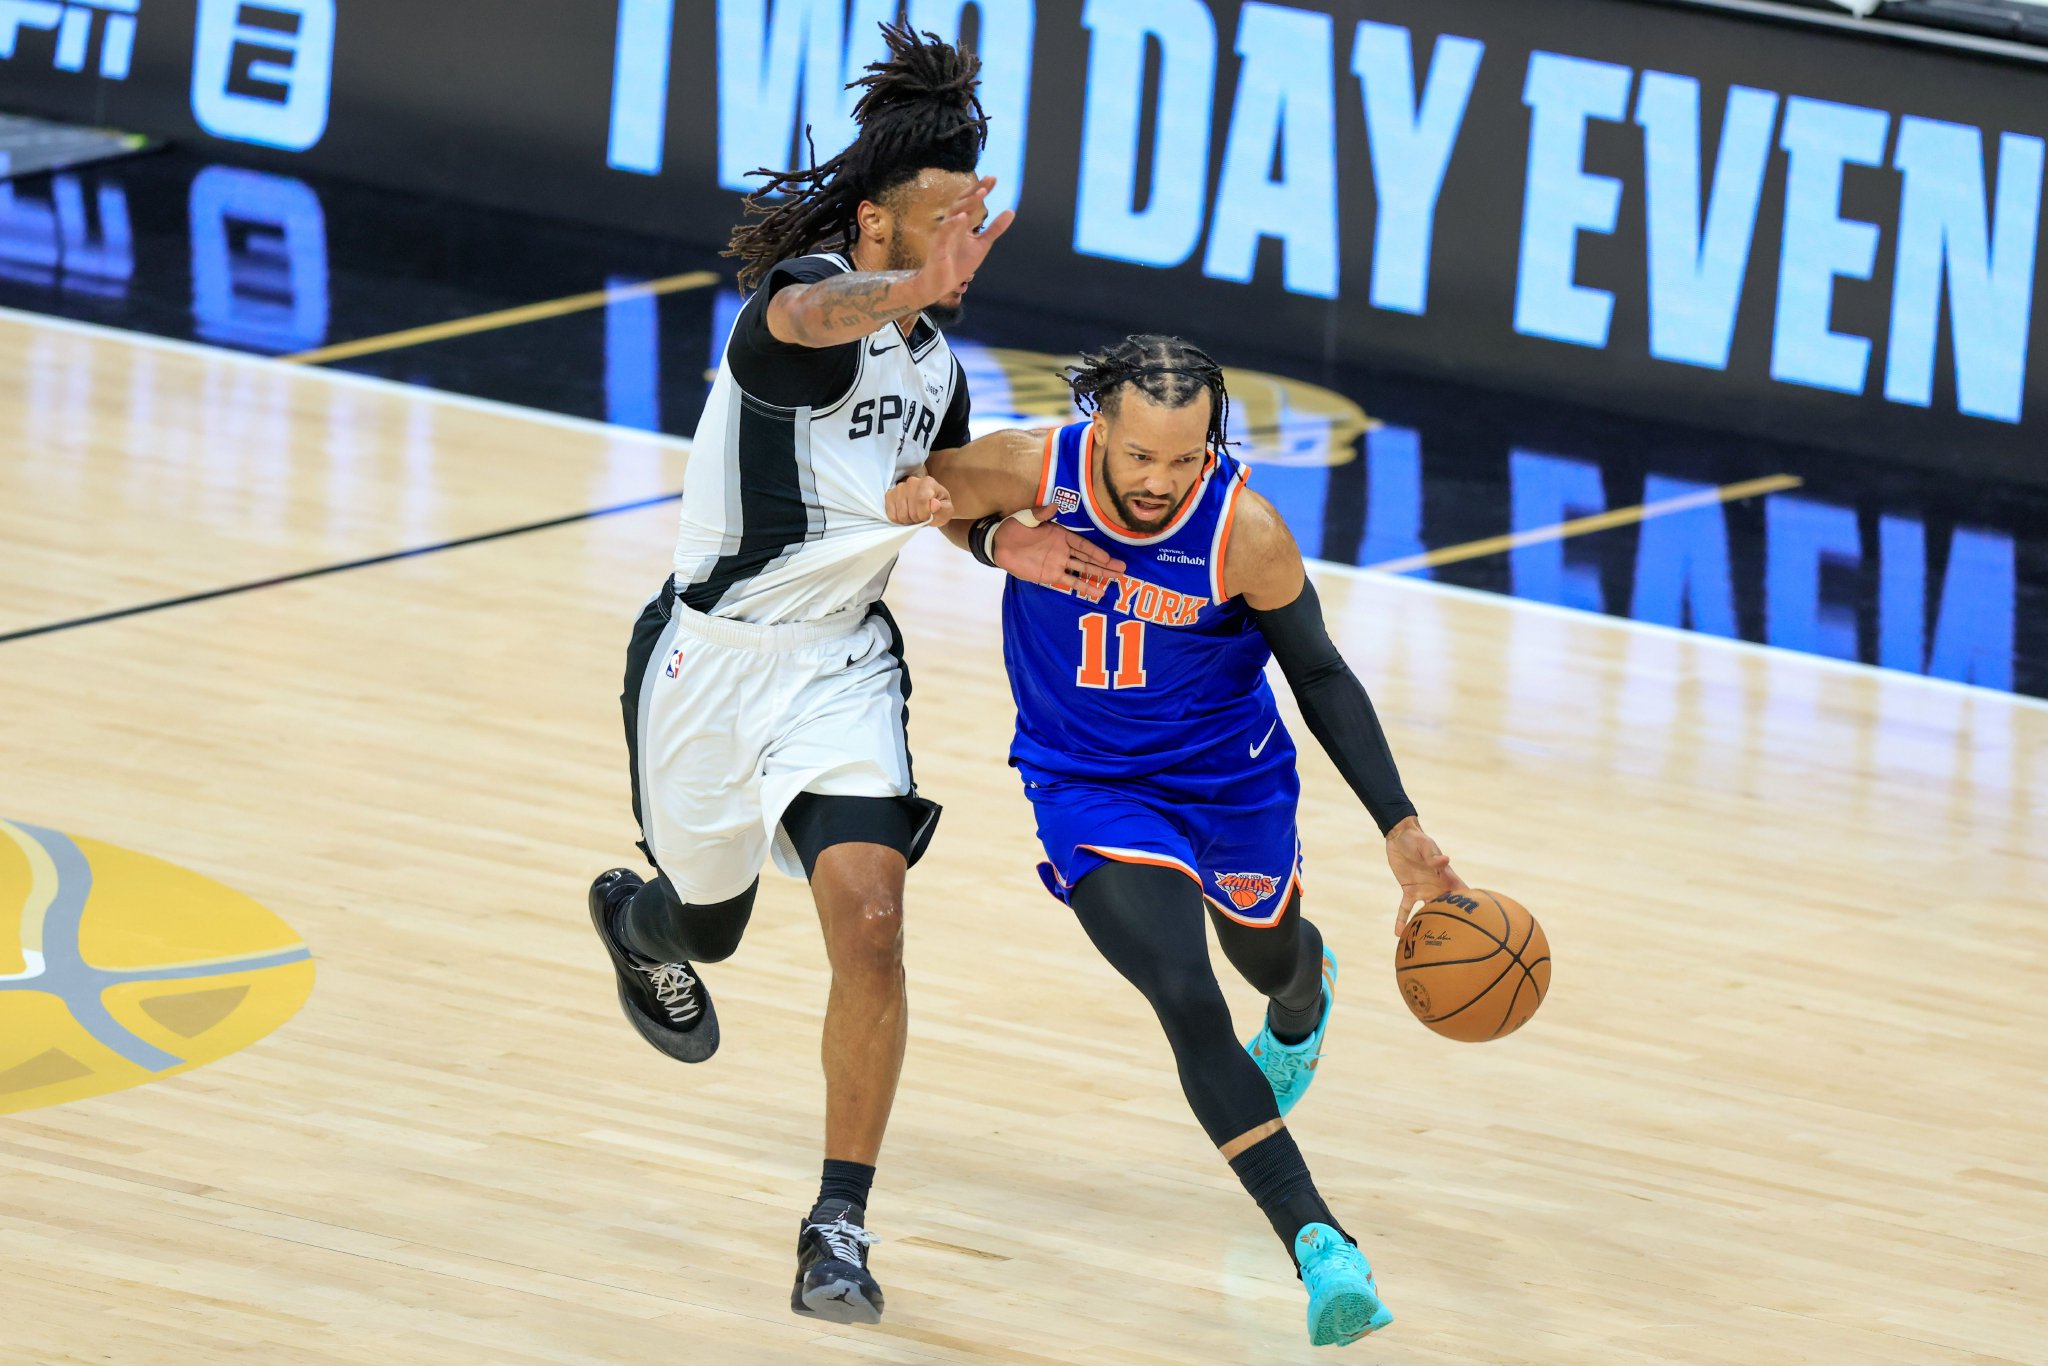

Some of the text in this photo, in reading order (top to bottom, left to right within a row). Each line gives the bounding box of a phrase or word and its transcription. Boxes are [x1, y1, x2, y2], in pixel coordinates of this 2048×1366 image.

[1073, 0, 1486, 316] DAY
[1513, 50, 2046, 424] EVEN
[1057, 489, 1077, 501] USA
[1156, 553, 1206, 566] abu dhabi
[1113, 574, 1210, 627] YORK
[1076, 611, 1147, 690] 11
[1217, 874, 1275, 894] KNICKS
